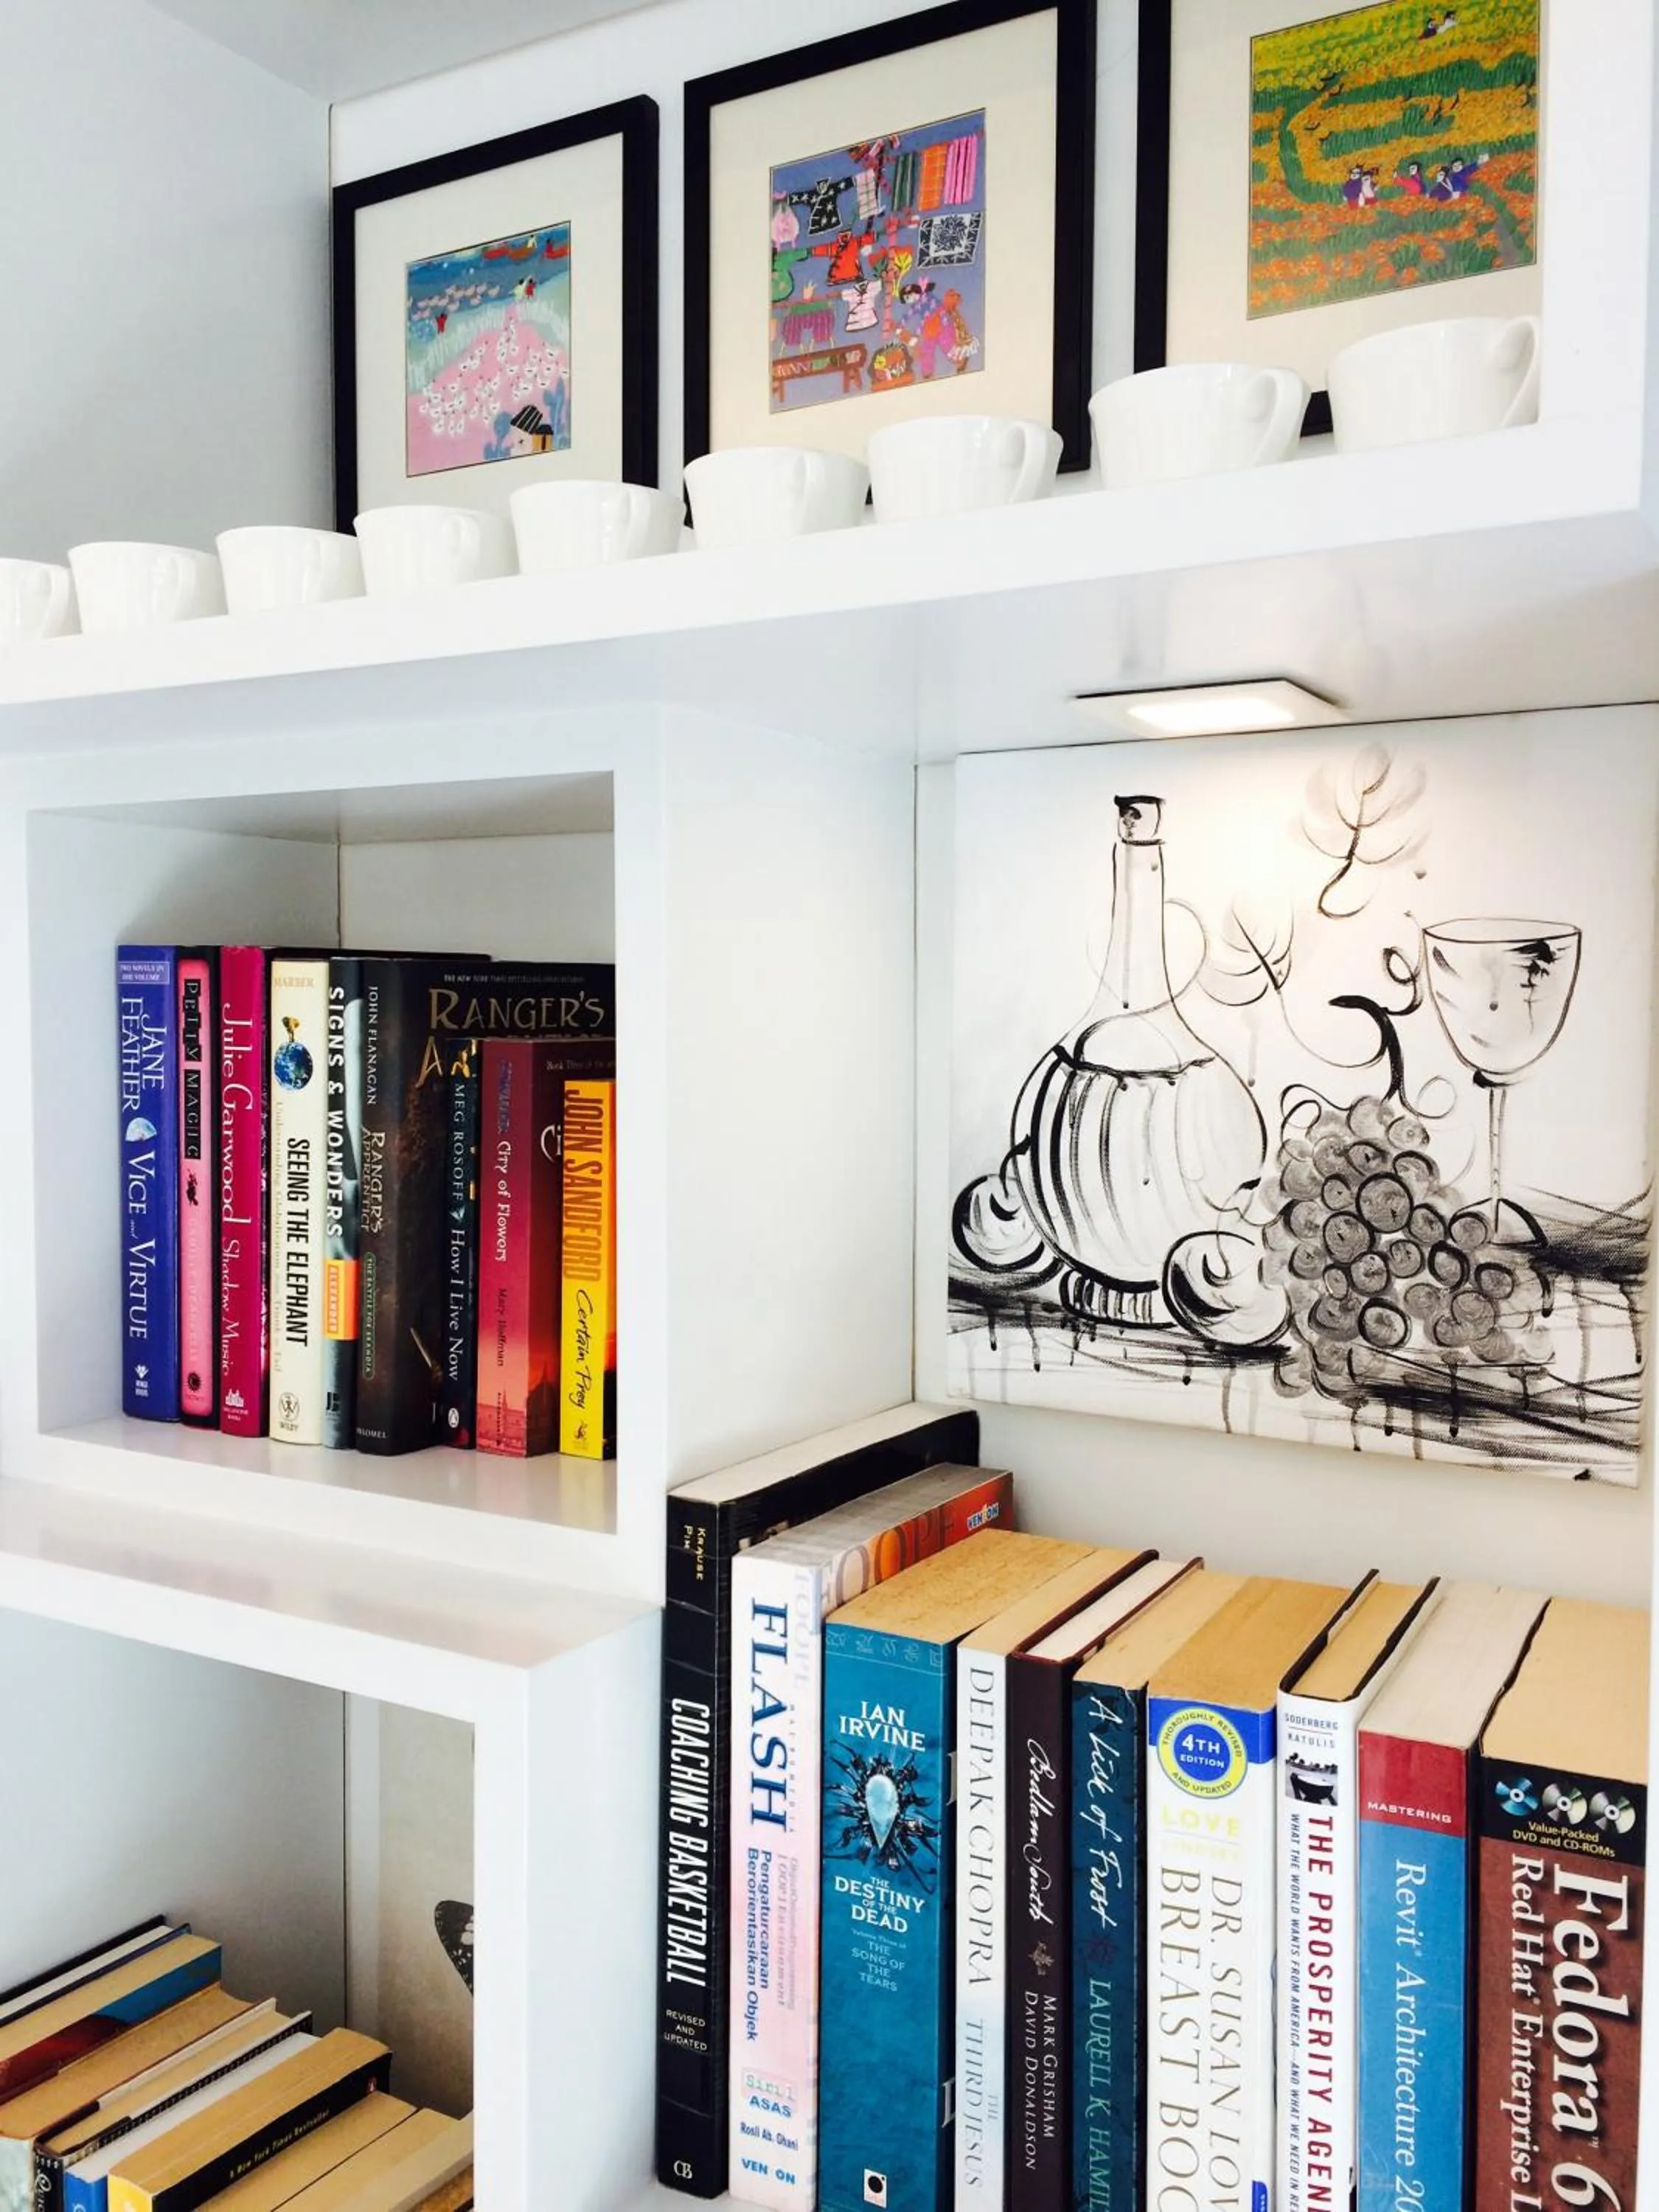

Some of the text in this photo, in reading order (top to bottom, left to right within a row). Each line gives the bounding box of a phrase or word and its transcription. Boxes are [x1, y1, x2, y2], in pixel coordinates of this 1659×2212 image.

[184, 982, 200, 1060] PETTY
[428, 987, 605, 1030] RANGER'S
[122, 997, 143, 1112] FEATHER
[141, 1014, 167, 1090] JANE
[367, 986, 378, 1105] JOHN FLANAGAN
[186, 1072, 200, 1158] MAGIC
[221, 1003, 254, 1224] Julie Garwood
[327, 987, 344, 1239] SIGNS & WONDERS
[564, 1088, 604, 1154] JOHN
[453, 1083, 465, 1202] MEG ROSOFF
[495, 1141, 511, 1175] City
[128, 1151, 156, 1215] VICE
[370, 1131, 386, 1234] RANGER'S
[497, 1179, 511, 1198] of
[495, 1203, 511, 1262] Flowers
[563, 1158, 603, 1282] SANDFORD
[285, 1137, 310, 1347] SEEING THE ELEPHANT
[449, 1229, 465, 1275] How
[128, 1239, 156, 1340] VIRTUE
[223, 1239, 240, 1377] Shadow Music
[449, 1293, 464, 1331] Live
[448, 1338, 464, 1381] Now
[568, 1288, 594, 1410] Certain Prey
[695, 1527, 706, 1582] KRAUSE
[749, 1597, 788, 1833] FLASH
[861, 1700, 905, 1726] IAN
[1088, 1696, 1123, 1725] A
[1162, 1711, 1214, 1745] THOROUGHLY
[1284, 1712, 1339, 1731] SODERBERG
[839, 1715, 926, 1753] IRVINE
[1181, 1733, 1220, 1755] 4TH
[1287, 1732, 1335, 1749] KATULIS
[1180, 1753, 1225, 1769] EDITION
[1172, 1772, 1233, 1794] AND UPDATED
[967, 1666, 995, 1984] DEEPAK CHOPRA
[1290, 1813, 1301, 1845] WHAT
[1368, 1801, 1452, 1824] MASTERING
[1528, 1821, 1600, 1843] Value-Packed
[666, 1697, 711, 1987] COACHING BASKETBALL
[1290, 1847, 1301, 1870] THE
[1308, 1815, 1334, 1876] THE
[1513, 1829, 1616, 1858] DVD and CD-ROMs
[835, 1875, 925, 1913] DESTINY
[871, 1877, 890, 1888] THE
[1088, 1846, 1122, 1927] Frost
[1290, 1873, 1301, 1915] WORLD
[1511, 1853, 1545, 1924] Red
[759, 1849, 773, 1991] Pengaturcaraan
[851, 1904, 908, 1933] DEAD
[862, 1899, 897, 1915] OF THE
[1209, 1875, 1242, 1944] DR.
[745, 1847, 759, 2042] Berorientasikan Objek
[851, 1947, 906, 1971] SONG OF
[868, 1941, 891, 1955] THE
[1290, 1918, 1300, 1958] WANTS
[858, 1971, 898, 1992] TEARS
[867, 1963, 891, 1978] THE
[1159, 1865, 1201, 2085] BREAST
[1290, 1961, 1300, 1992] FROM
[666, 2008, 706, 2028] REVISED
[1307, 1891, 1334, 2104] PROSPERITY
[664, 2034, 707, 2051] UPDATED
[675, 2023, 695, 2037] AND
[1085, 1977, 1112, 2087] LAURELL
[1209, 1961, 1242, 2116] SUSAN
[1025, 1991, 1039, 2171] DAVID DONALDSON
[1043, 1993, 1058, 2138] MARK GRISHAM
[1394, 1964, 1426, 2168] Architecture
[749, 2095, 792, 2118] ASAS
[964, 2017, 984, 2188] THIRD JESUS
[987, 2093, 998, 2121] THE
[1085, 2092, 1112, 2119] K.
[1290, 2089, 1300, 2118] WHAT
[1500, 2008, 1545, 2184] Enterprise
[740, 2121, 760, 2138] Rosli
[776, 2132, 799, 2152] Ghani
[1290, 2121, 1300, 2139] WE
[1290, 2143, 1300, 2174] NEED
[1290, 2177, 1299, 2191] IN
[1550, 2161, 1621, 2212] 6
